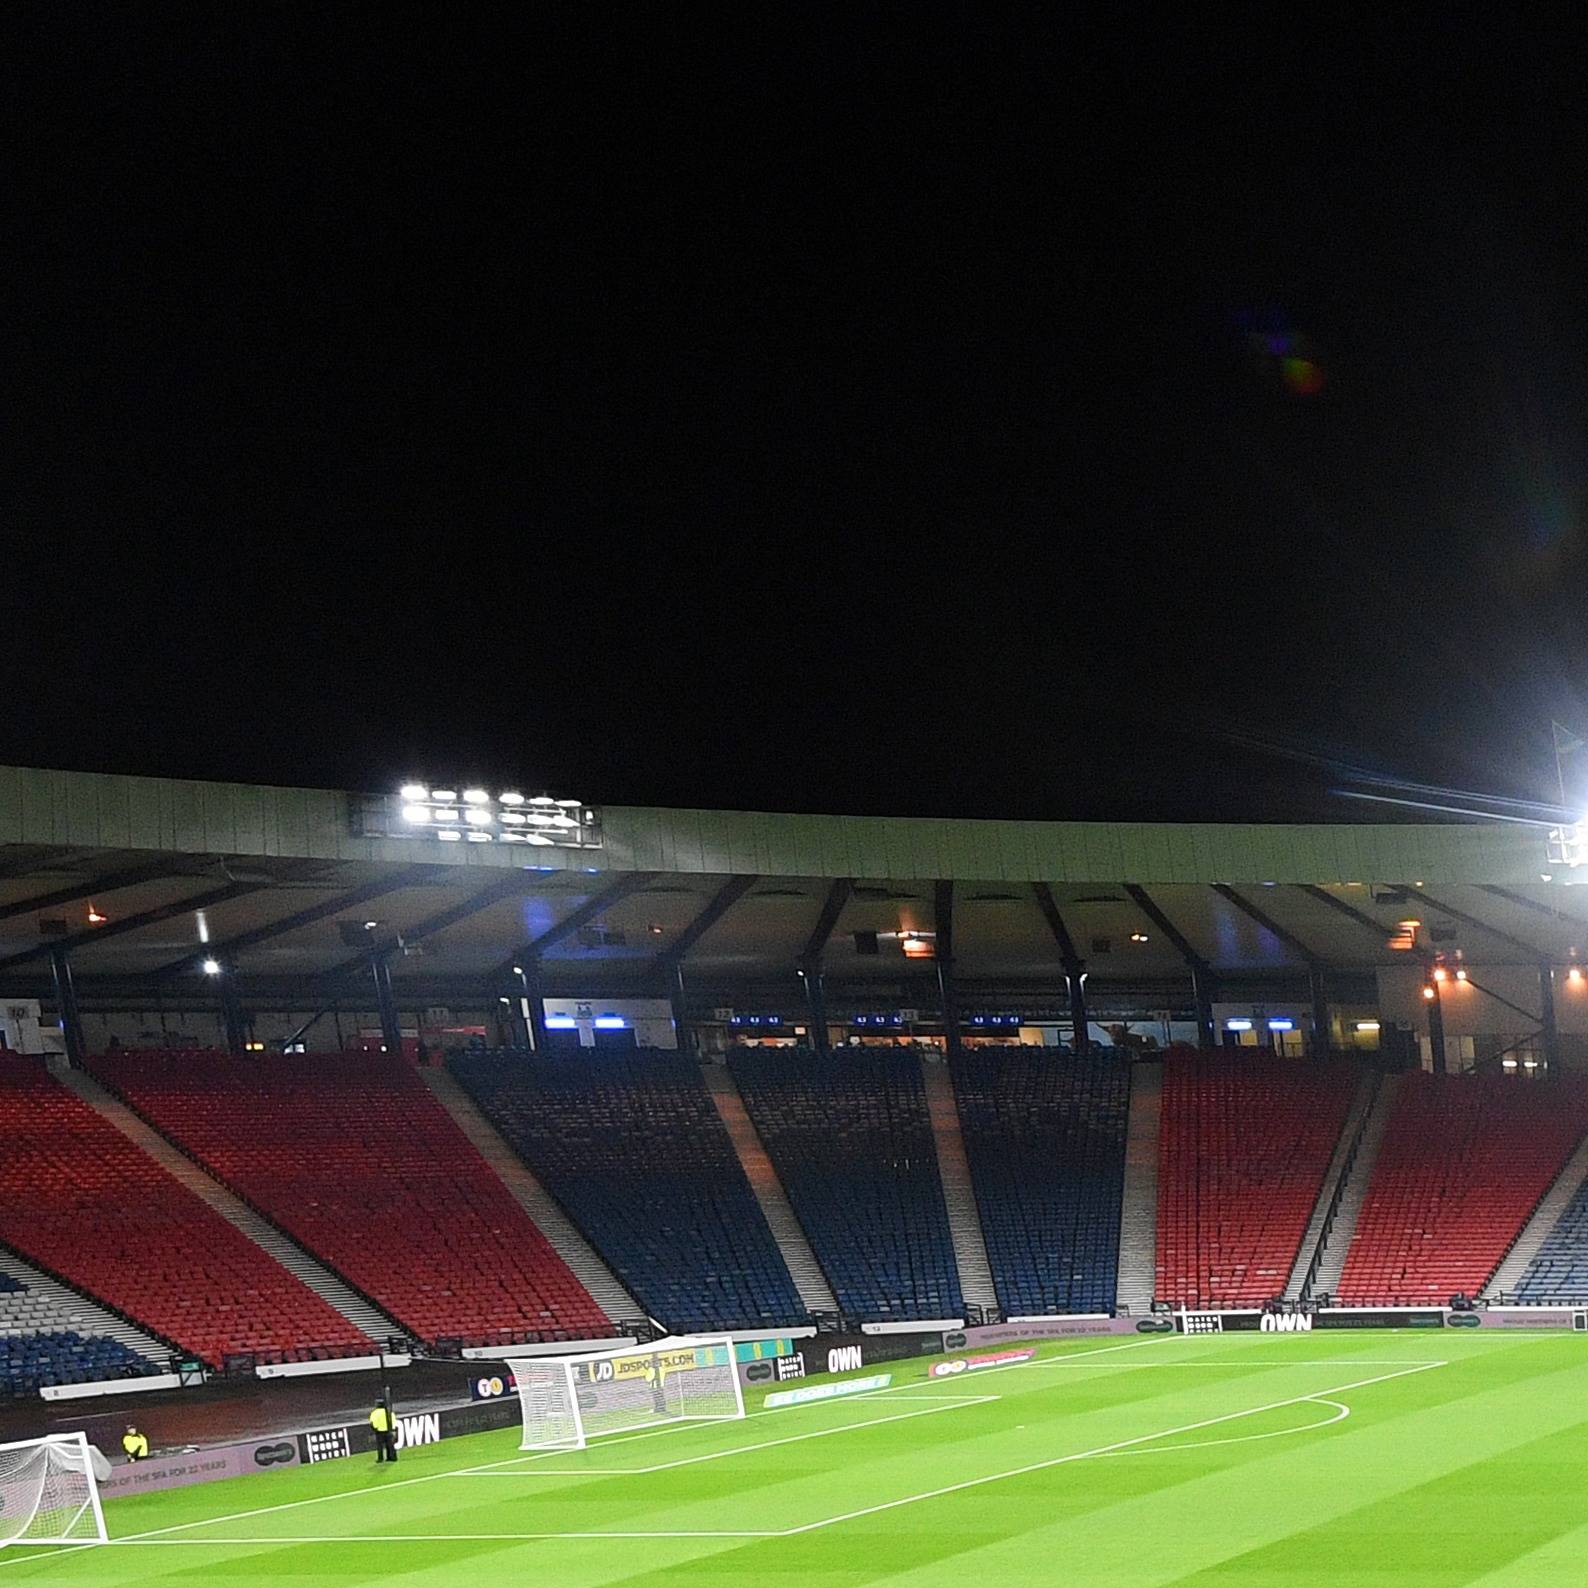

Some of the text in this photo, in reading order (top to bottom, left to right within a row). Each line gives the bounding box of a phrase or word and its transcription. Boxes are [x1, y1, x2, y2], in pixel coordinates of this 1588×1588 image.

[1260, 1313, 1312, 1331] OWN
[828, 1346, 862, 1373] OWN
[200, 1460, 227, 1472] YEARS
